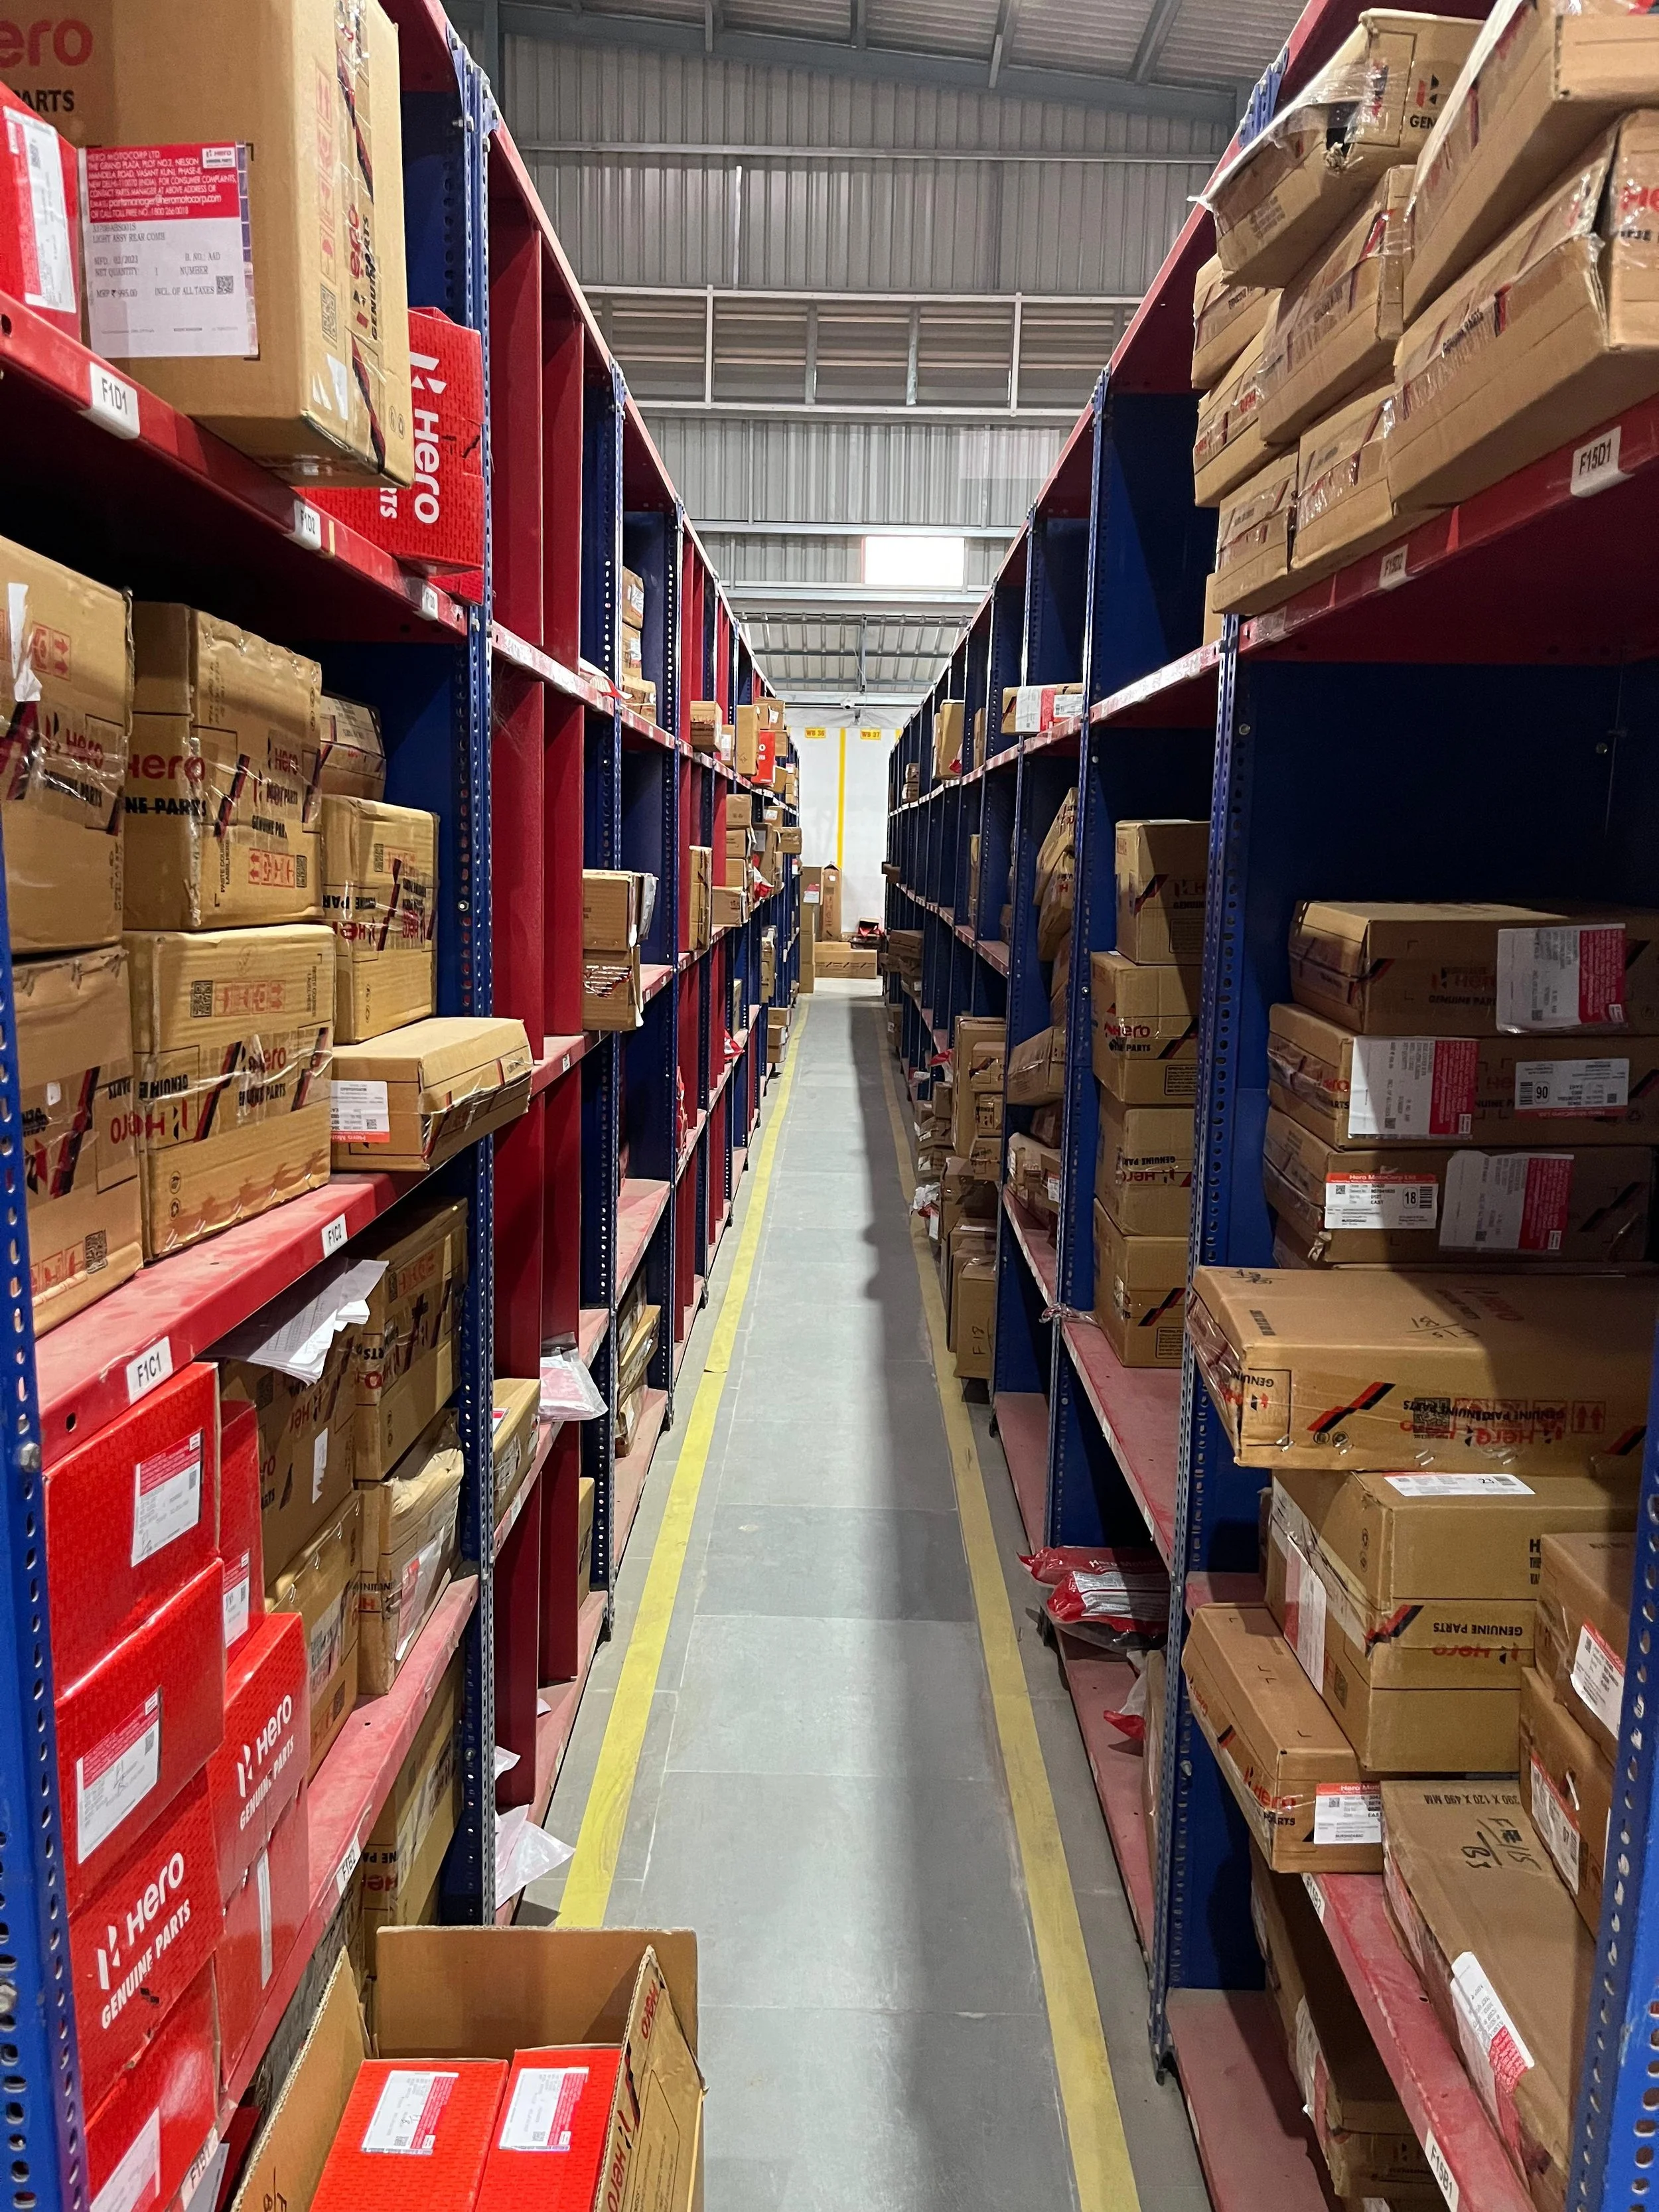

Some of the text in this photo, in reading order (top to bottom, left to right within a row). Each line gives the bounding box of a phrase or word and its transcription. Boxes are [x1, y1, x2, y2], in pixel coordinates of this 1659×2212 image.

[0, 19, 94, 68] ero
[14, 90, 74, 111] ARTS
[175, 157, 199, 166] NELSON
[136, 169, 159, 177] VASANT
[171, 176, 200, 184] CONSUMER
[184, 184, 206, 193] ADDRESS
[93, 234, 111, 244] LIGHT
[112, 234, 127, 242] ASSY
[128, 233, 145, 242] REAR
[95, 268, 108, 277] NET
[108, 267, 137, 277] QUANTITY
[180, 266, 208, 275] NUMBER
[172, 287, 181, 295] OF
[182, 286, 194, 295] ALL
[194, 285, 214, 295] TAXES
[101, 377, 127, 415] F1D1
[414, 408, 440, 524] Hero
[1579, 437, 1612, 476] F15D1
[300, 509, 316, 536] F1D2
[323, 895, 349, 909] PAR
[1126, 1043, 1151, 1053] PARTS
[138, 1074, 189, 1099] GENUINE
[266, 1082, 287, 1102] PARTS
[1329, 1100, 1349, 1110] ARTS
[110, 1110, 165, 1145] Hero
[1123, 1155, 1176, 1167] GENUINE PAR
[1404, 1191, 1416, 1205] 18
[328, 1223, 342, 1246] F1C2
[137, 1351, 162, 1389] F1C1
[1433, 1622, 1524, 1637] GENUINE PARTS
[256, 1694, 292, 1766] Hero
[273, 1735, 294, 1782] PARTS
[1423, 1794, 1443, 1805] MM
[1445, 1795, 1461, 1805] 490
[1473, 1795, 1490, 1805] 120
[342, 1849, 356, 1881] F1B2
[126, 1852, 184, 1947] Hero
[101, 1898, 191, 2029] GENUINE PARTS
[641, 1979, 660, 2040] Hero
[1430, 2144, 1453, 2201] F15B1
